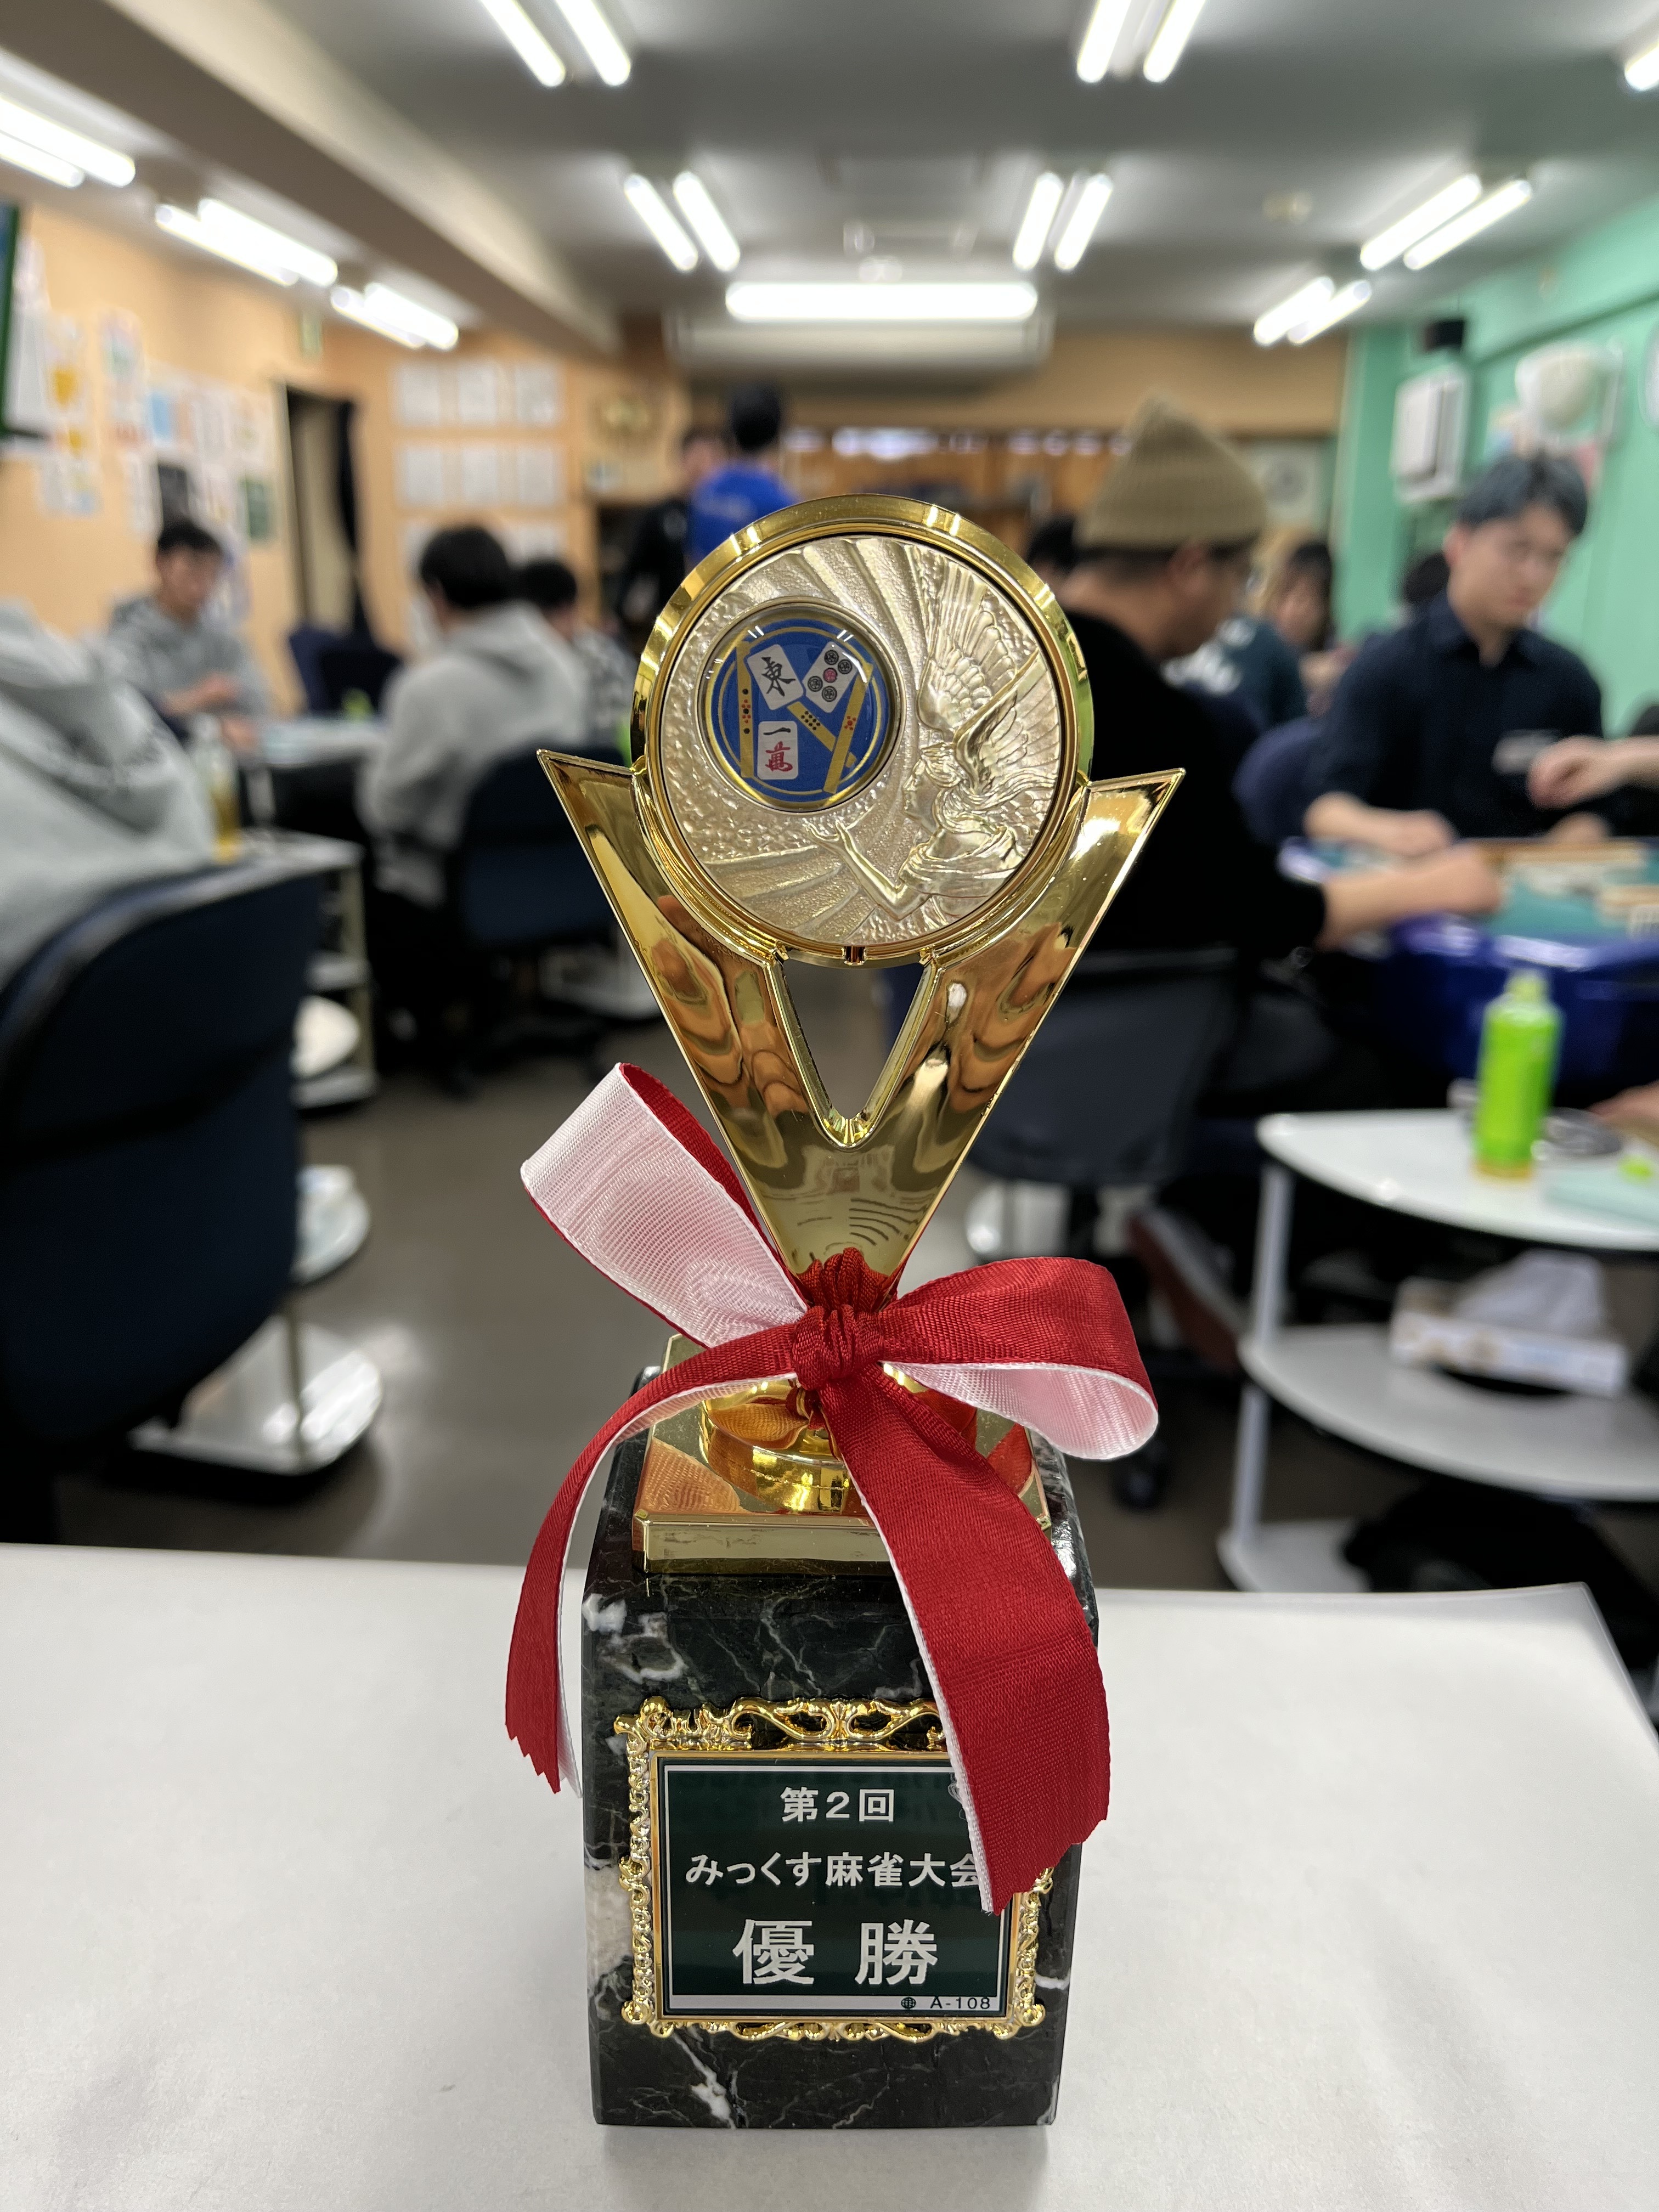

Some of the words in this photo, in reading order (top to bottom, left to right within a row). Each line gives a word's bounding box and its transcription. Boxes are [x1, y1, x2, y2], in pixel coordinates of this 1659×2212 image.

[761, 657, 795, 697] 東
[781, 1787, 894, 1822] 第2回
[685, 1852, 979, 1887] みっくす麻雀大会
[930, 1996, 990, 2009] A-108
